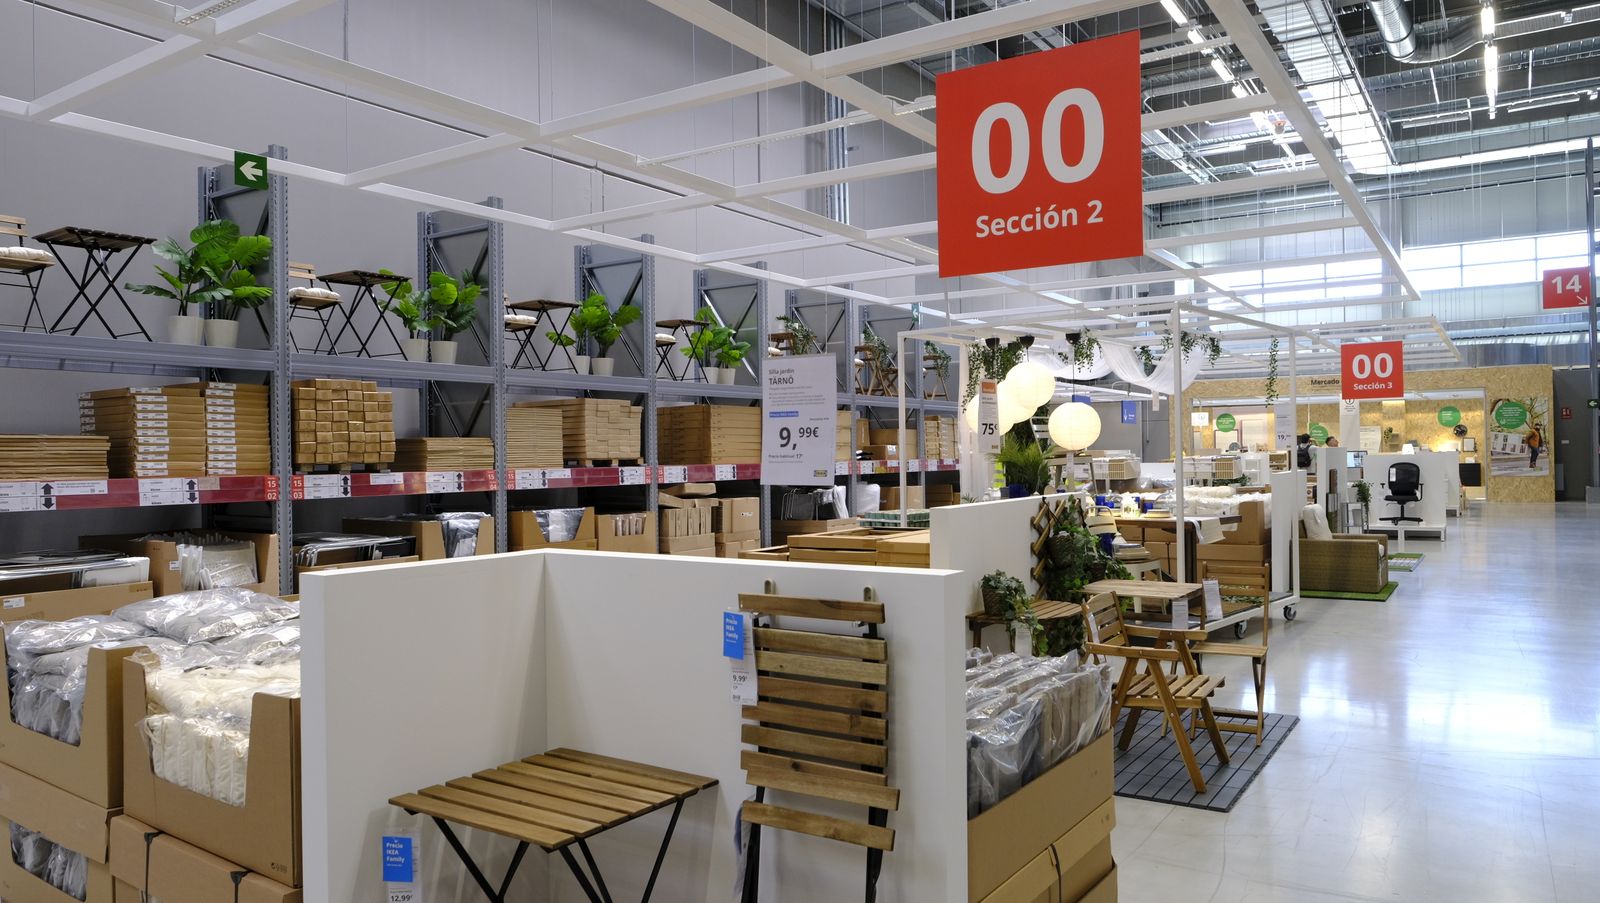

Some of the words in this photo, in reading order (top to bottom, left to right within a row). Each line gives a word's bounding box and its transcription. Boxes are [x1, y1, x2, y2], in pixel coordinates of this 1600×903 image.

[972, 87, 1105, 195] 00
[975, 204, 1079, 238] Sección
[1087, 199, 1104, 224] 2
[1551, 274, 1582, 294] 14
[1352, 352, 1394, 379] 00
[1310, 378, 1340, 386] Mercado
[1353, 381, 1386, 391] Sección
[1387, 381, 1393, 389] 3
[268, 480, 277, 488] 15
[293, 480, 303, 488] 15
[267, 492, 277, 500] 02
[293, 491, 303, 499] 03
